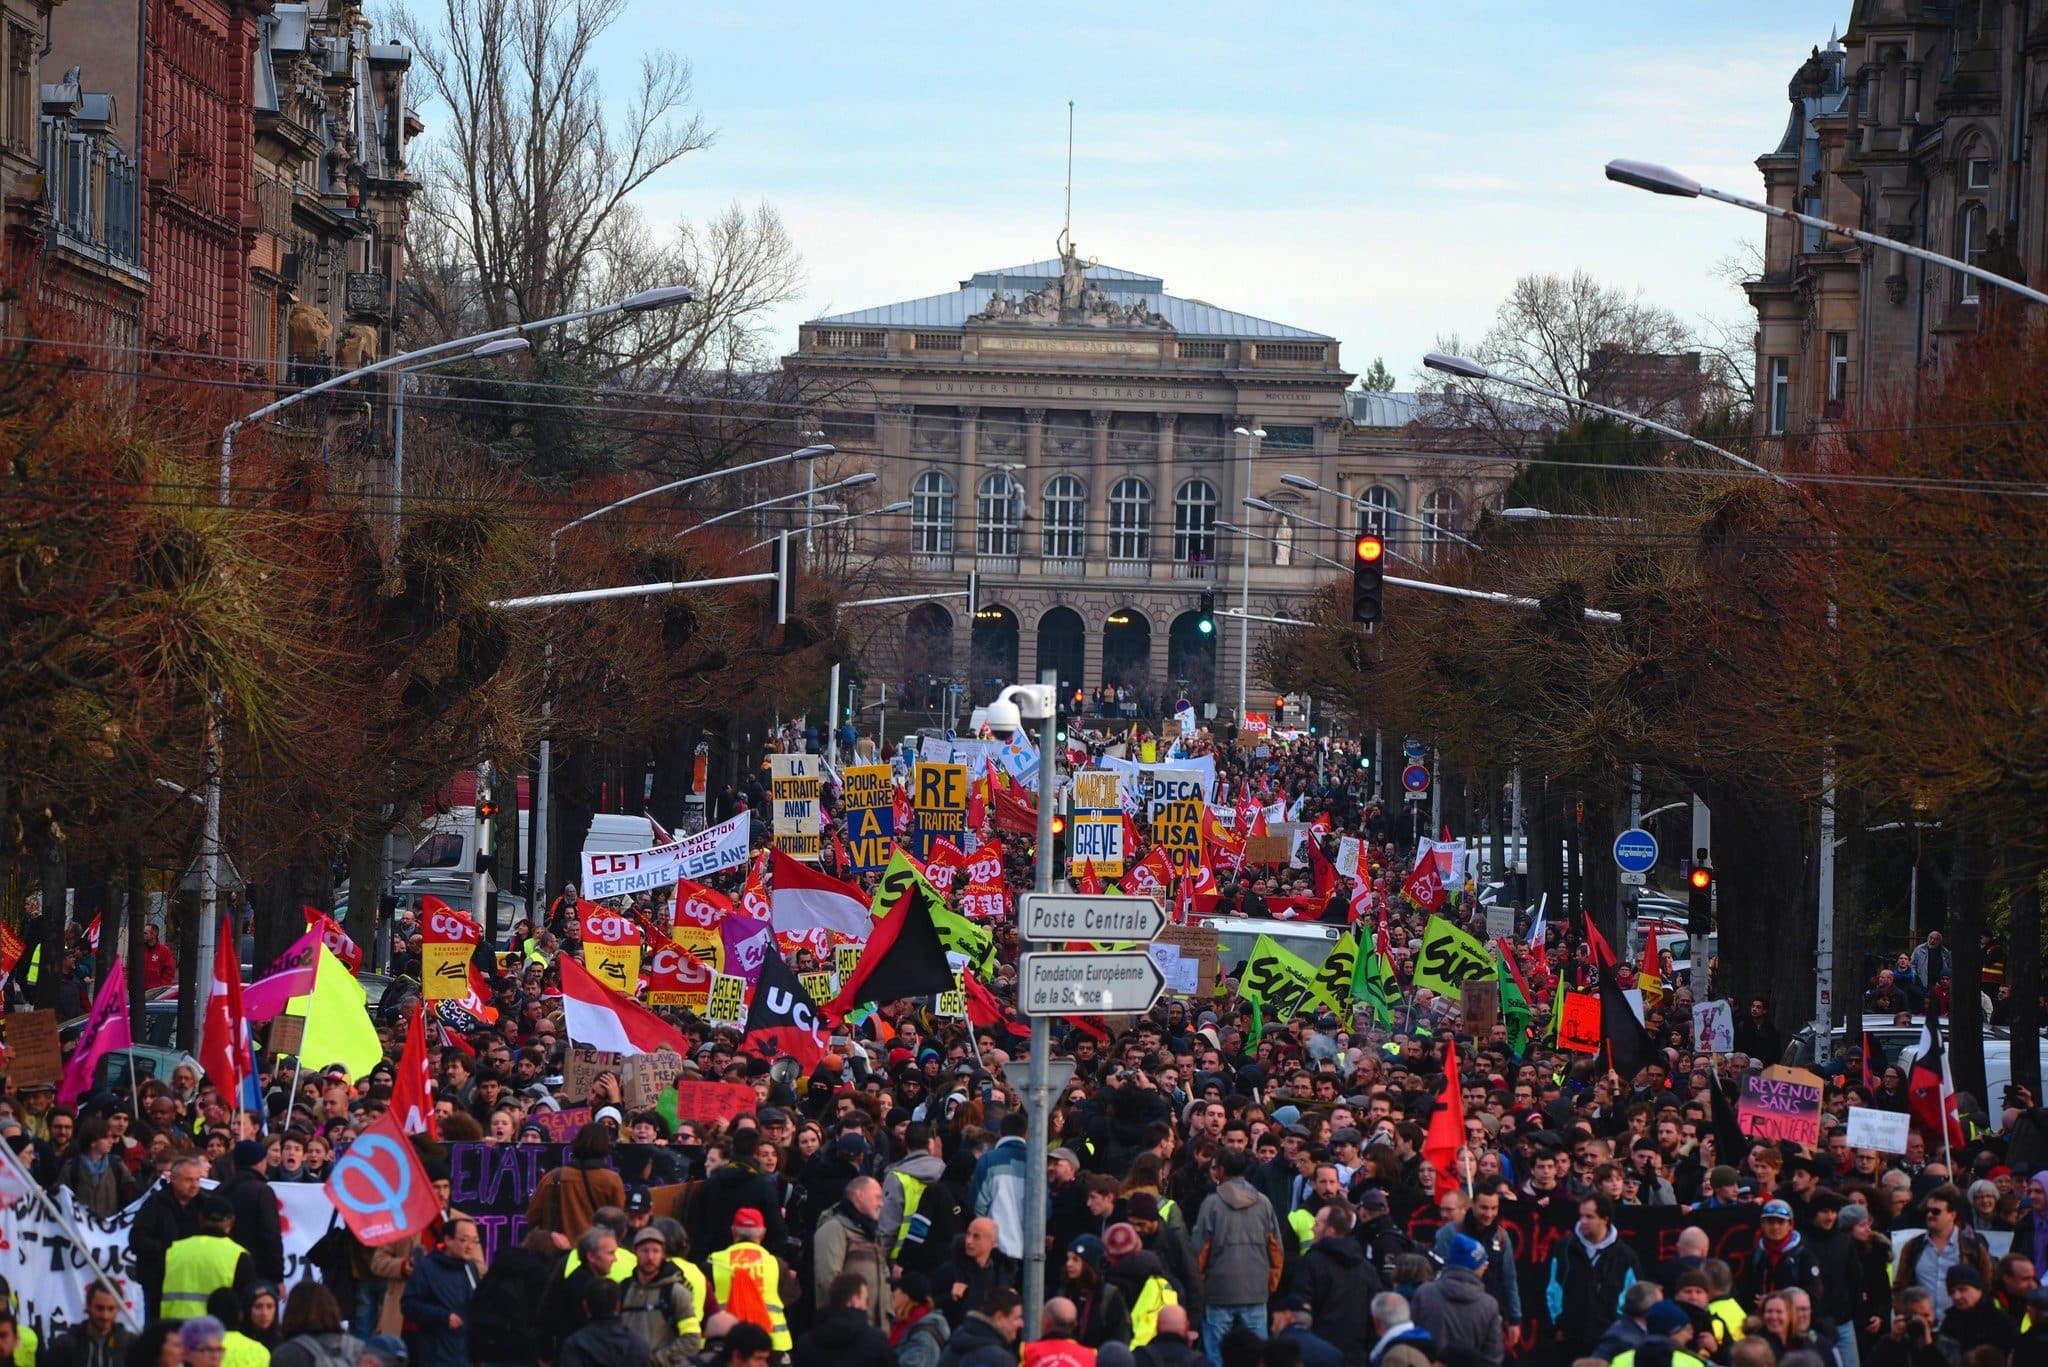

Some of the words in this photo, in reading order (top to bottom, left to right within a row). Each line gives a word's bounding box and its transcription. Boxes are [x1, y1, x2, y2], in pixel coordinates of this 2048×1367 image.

[935, 382, 1040, 395] UNIVERSITÉ
[1057, 387, 1073, 396] DE
[1092, 388, 1204, 400] STRASBOURG
[791, 760, 805, 776] LA
[774, 780, 819, 800] RETRAITE
[846, 774, 877, 792] POUR
[879, 779, 890, 789] LE
[921, 768, 961, 808] RE
[1155, 780, 1201, 801] DECA
[785, 801, 812, 817] AVANT
[846, 790, 892, 809] SALAIRE
[860, 809, 881, 837] A
[918, 812, 964, 831] TRAITRE
[1091, 809, 1103, 821] OU
[1154, 802, 1199, 824] PITA
[776, 836, 817, 854] ARTHRITE
[1076, 823, 1118, 862] GREVE
[1153, 825, 1199, 846] LISA
[591, 853, 643, 876] CGT
[649, 822, 735, 856] CONSTRUCTION
[673, 840, 717, 861] ALSACE
[850, 837, 891, 868] VIE
[593, 868, 671, 896] RETRAITE
[587, 917, 634, 941] cgt
[1034, 907, 1075, 928] Poste
[1085, 909, 1147, 930] Centrale
[1034, 965, 1083, 982] Fondation
[1086, 964, 1144, 984] Européenne
[713, 977, 731, 995] ART
[732, 979, 743, 999] EN
[1034, 989, 1046, 1004] de
[1050, 988, 1058, 1003] la
[1062, 987, 1101, 1004] Scnce
[710, 999, 740, 1020] GREVE
[1749, 1076, 1820, 1102] REVENUS
[1757, 1095, 1800, 1113] SANS
[1740, 1112, 1818, 1145] FRONTIERE
[452, 1142, 548, 1205] ETAT
[43, 1234, 138, 1280] TOUS
